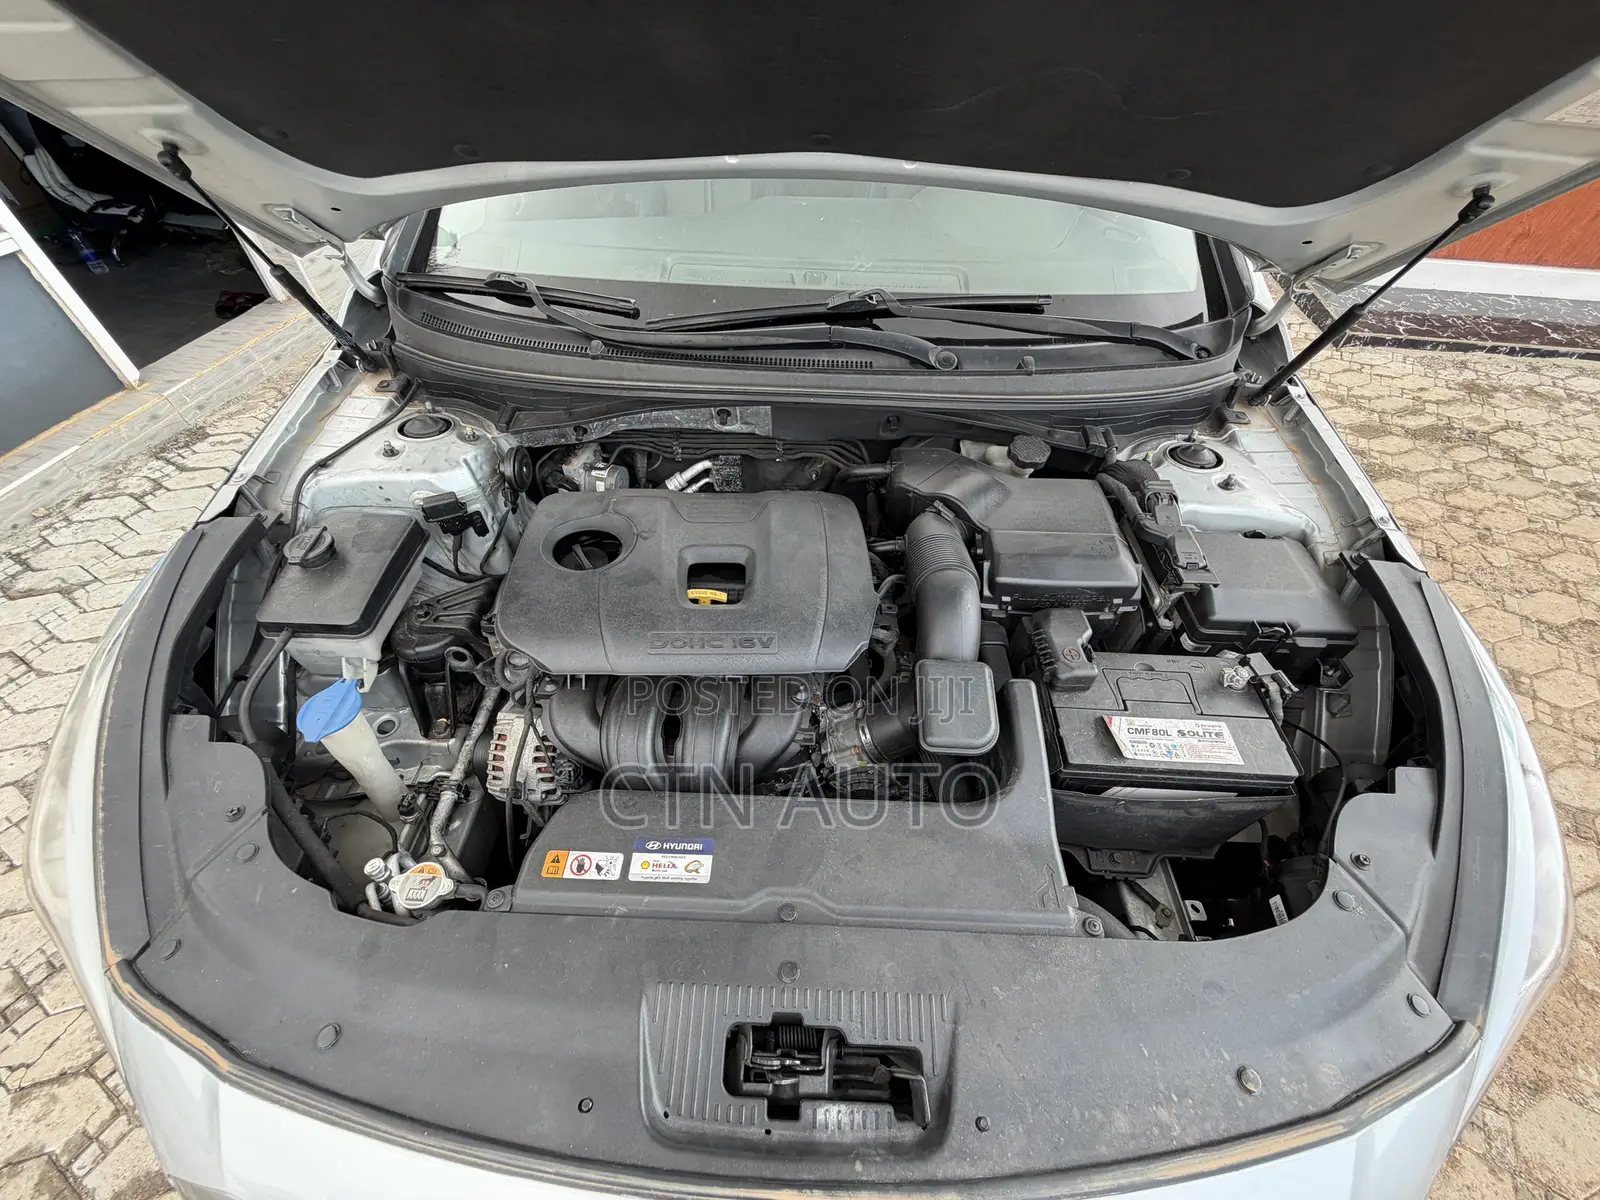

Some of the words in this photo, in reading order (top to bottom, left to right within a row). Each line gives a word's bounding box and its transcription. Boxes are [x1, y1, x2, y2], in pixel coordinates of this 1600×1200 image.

[649, 637, 724, 650] DOHC
[732, 637, 776, 649] 16V
[1127, 727, 1172, 737] CMF80L
[1177, 729, 1225, 738] SOLITE
